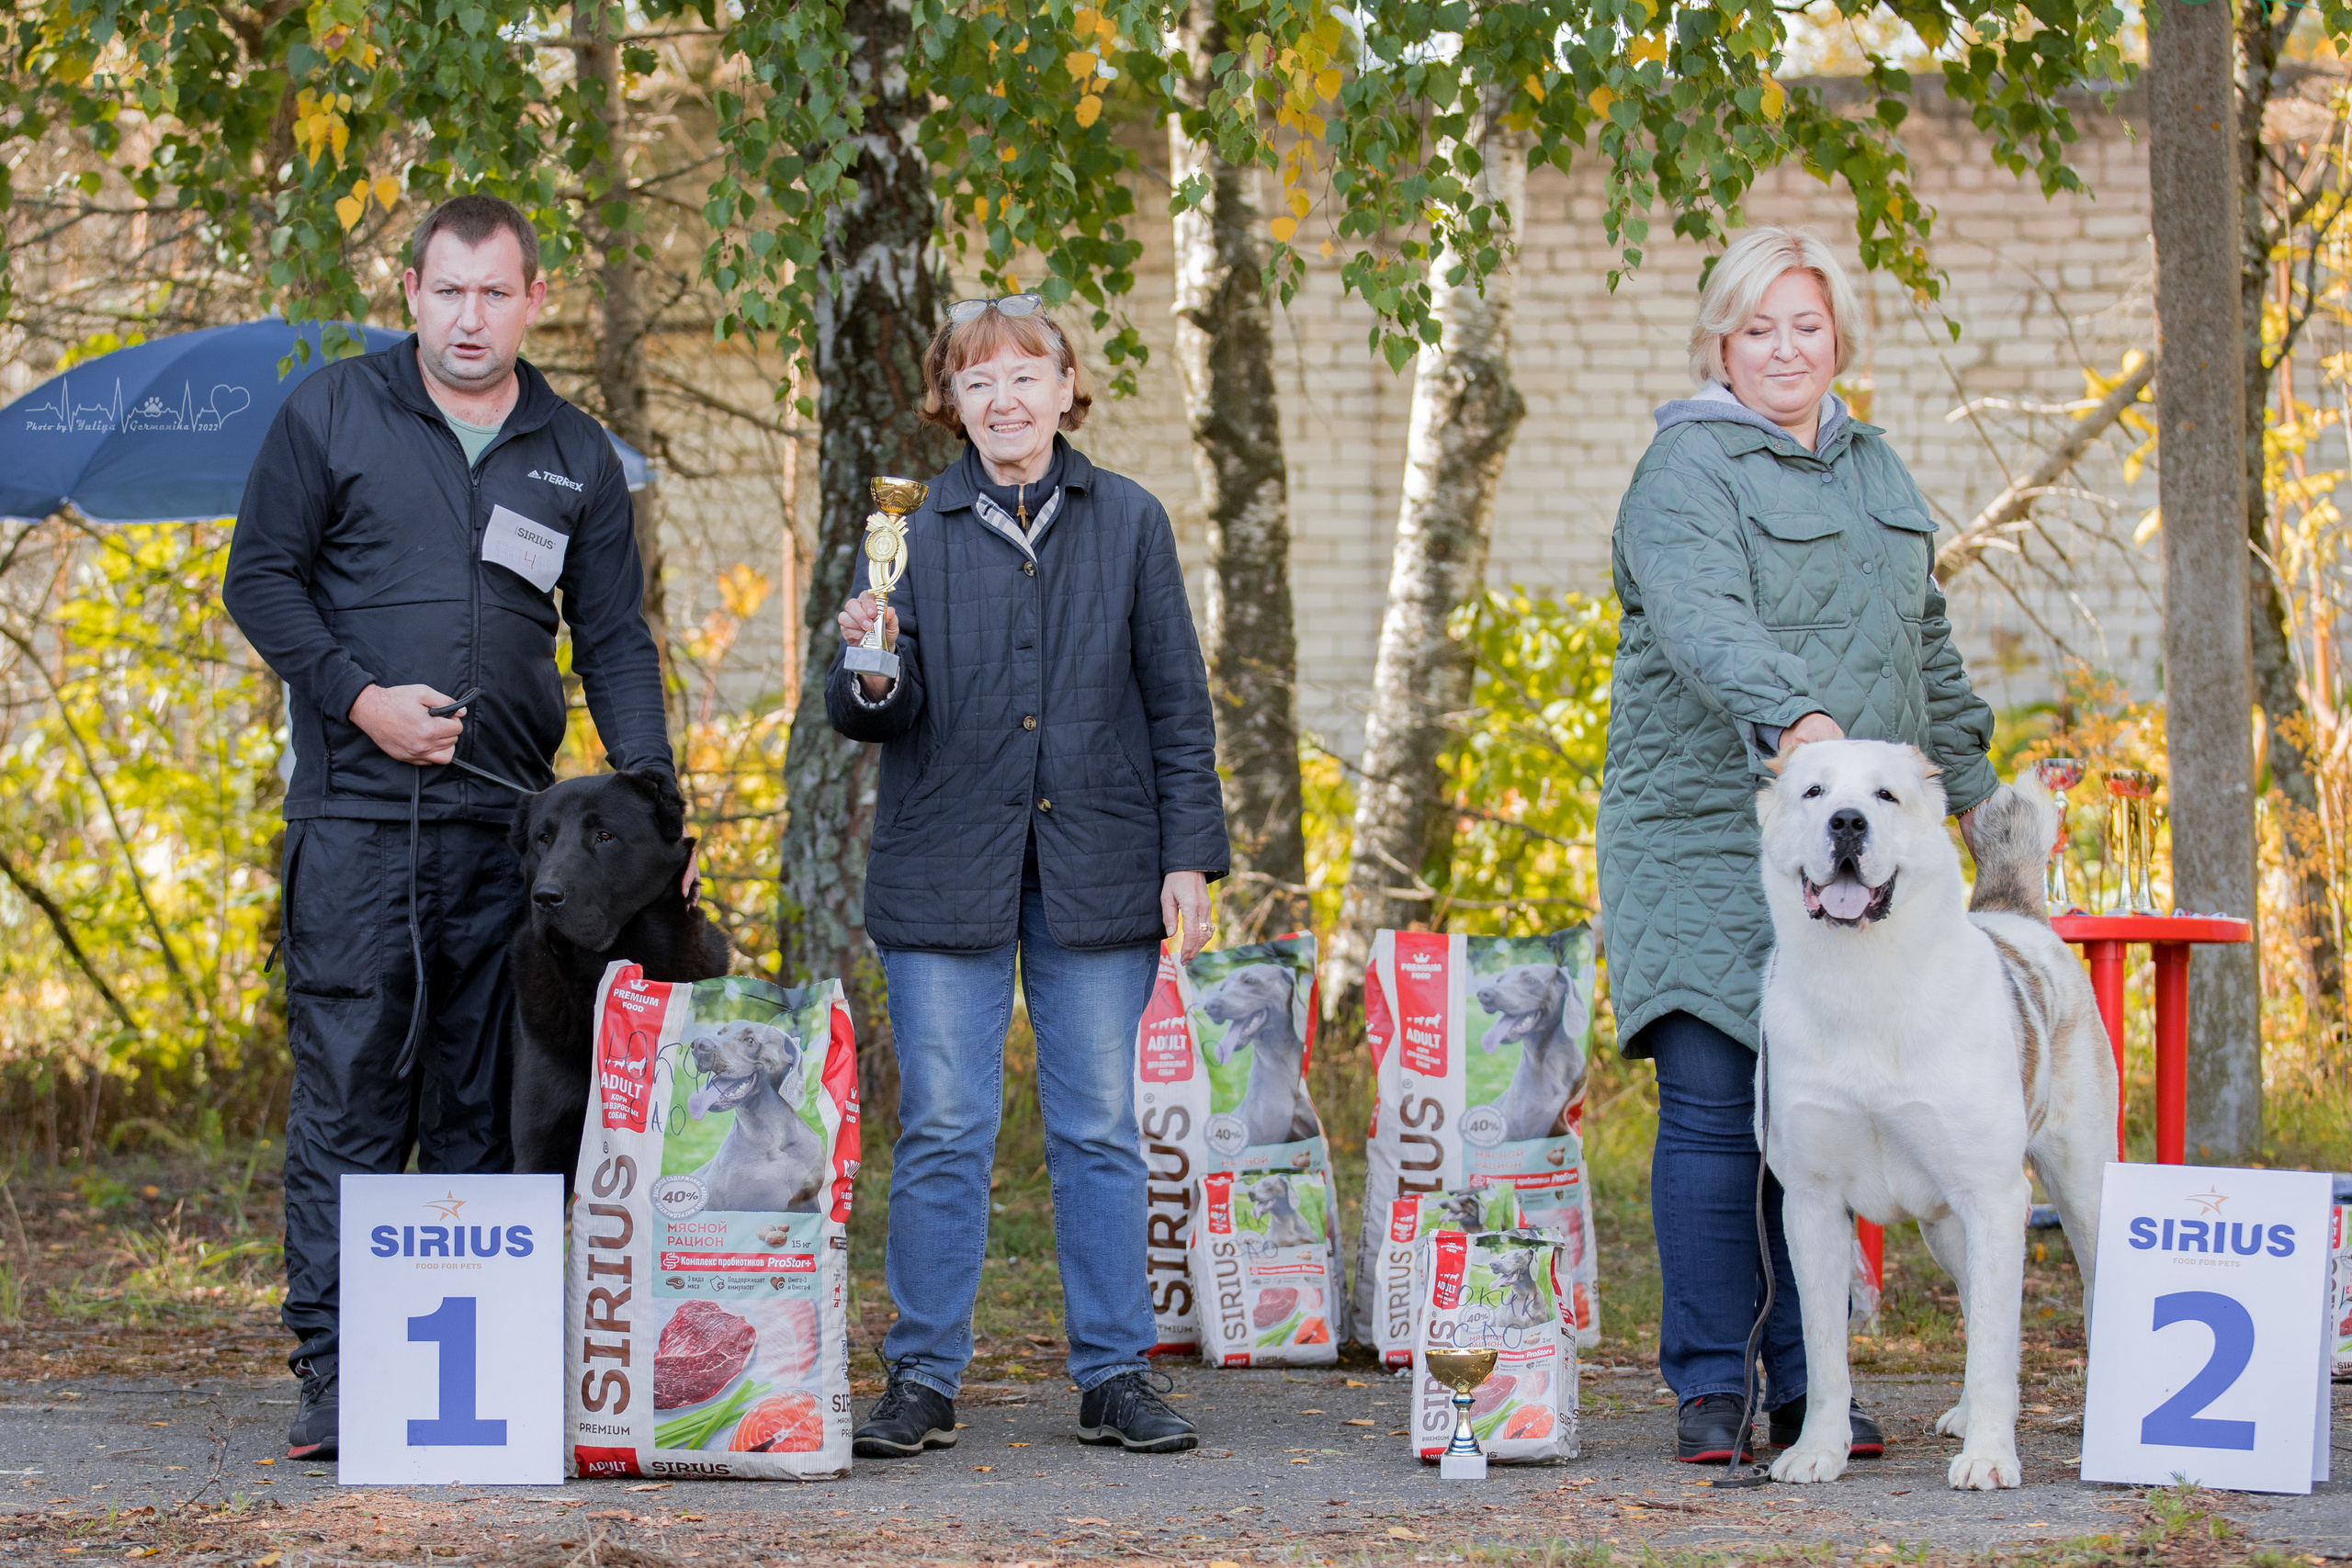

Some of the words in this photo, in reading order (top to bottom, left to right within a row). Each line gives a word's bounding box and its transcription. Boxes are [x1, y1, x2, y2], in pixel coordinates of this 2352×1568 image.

[542, 470, 583, 492] TERREX
[517, 526, 554, 550] SIRIUS
[525, 551, 537, 570] 4
[613, 987, 660, 1007] PREMIUM
[622, 1001, 644, 1013] FOOD
[1148, 1034, 1187, 1052] ADULT
[1407, 1027, 1442, 1049] ADULT
[600, 1071, 644, 1100] ADULT
[611, 1092, 628, 1104] КОРМ
[607, 1111, 628, 1120] СОБАК
[1215, 1127, 1241, 1141] 40%
[1469, 1119, 1499, 1132] 40%
[1398, 1093, 1445, 1198] IUS
[662, 1190, 698, 1204] 40%
[1142, 1105, 1193, 1317] SIRIUS
[667, 1220, 728, 1234] МЯСНОЙ
[370, 1224, 535, 1258] SIRIUS
[667, 1235, 724, 1247] РАЦИОН
[791, 1239, 801, 1248] 15
[2128, 1215, 2296, 1258] SIRIUS
[681, 1256, 717, 1266] Комплекс
[718, 1257, 764, 1268] пробиотиков
[767, 1257, 811, 1268] ProStor+
[581, 1154, 638, 1416] SIRIUS
[1213, 1242, 1248, 1340] SIRIUS
[1388, 1249, 1413, 1339] SIRIUS
[1466, 1312, 1489, 1324] 40%
[1157, 1324, 1193, 1333] EMIUM
[406, 1296, 508, 1447] 1
[2140, 1290, 2256, 1451] 2
[831, 1393, 852, 1414] SIR
[579, 1422, 630, 1436] PREMIUM
[589, 1461, 627, 1472] ADULT
[651, 1461, 731, 1475] SIRIUS
